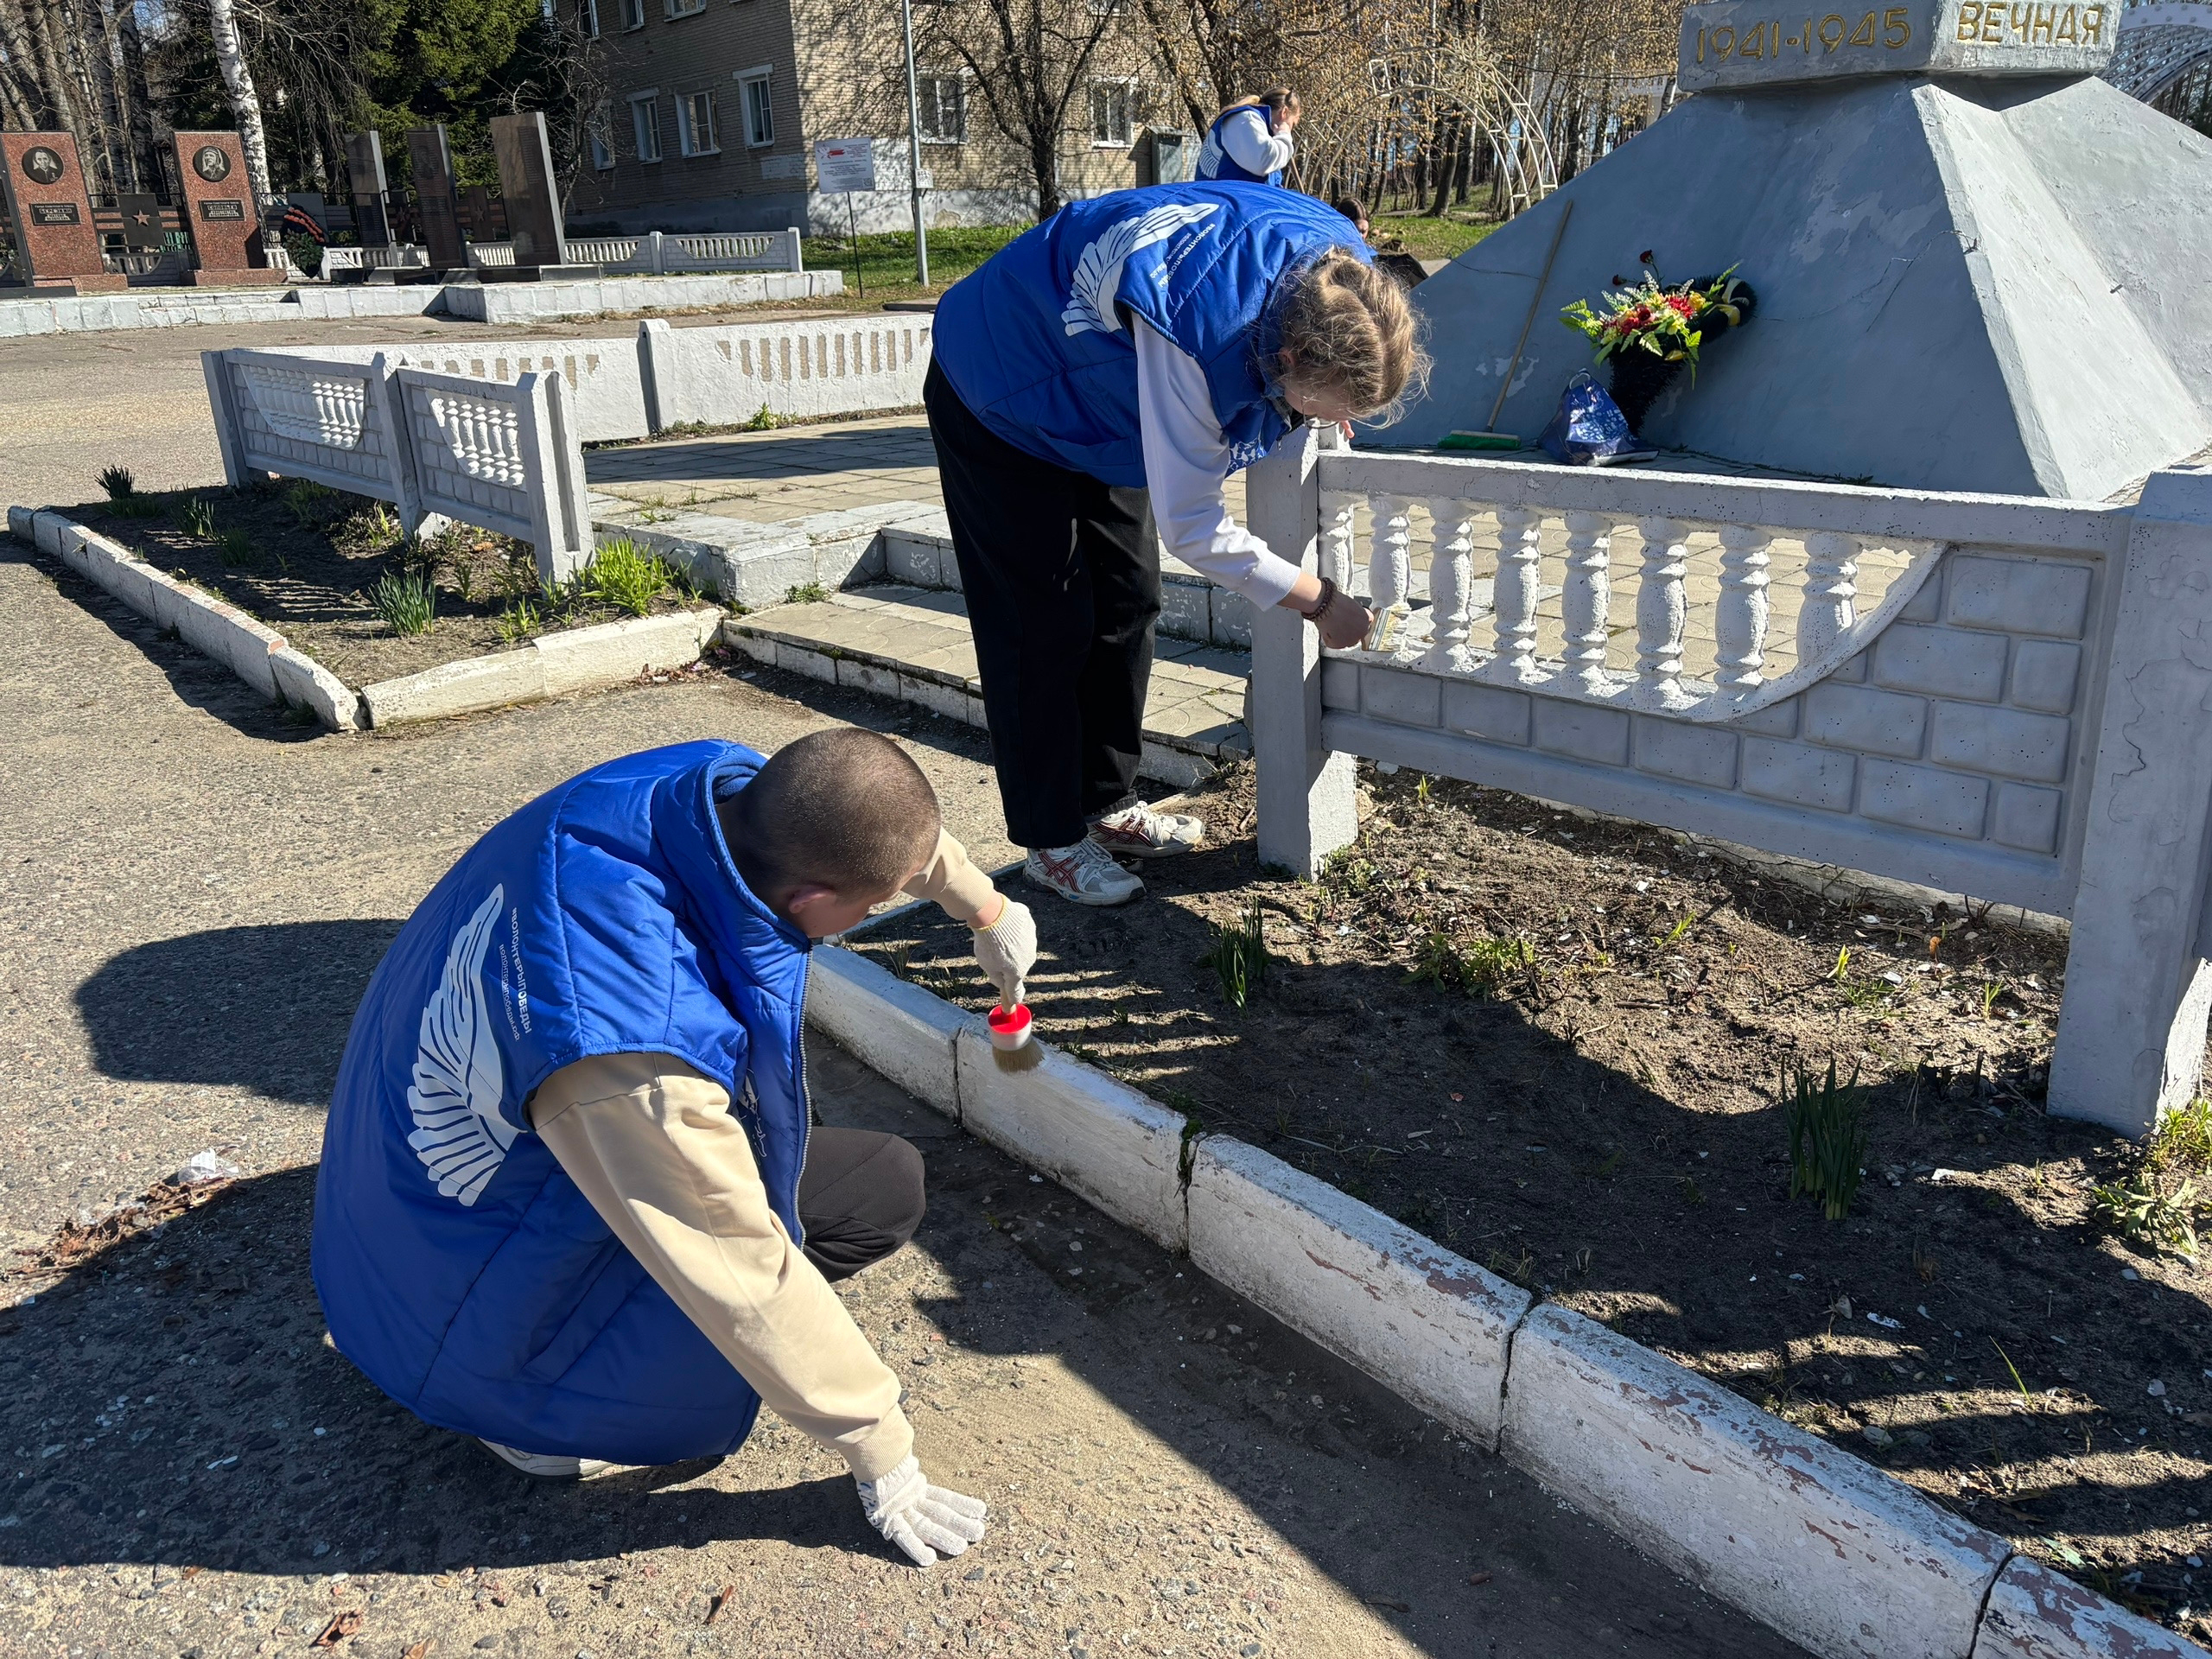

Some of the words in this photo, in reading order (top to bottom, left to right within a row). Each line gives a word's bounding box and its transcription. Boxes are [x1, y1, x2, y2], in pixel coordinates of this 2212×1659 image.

[1696, 8, 1910, 64] 1941-1945
[1957, 2, 2104, 46] ВЕЧНАЯ
[511, 907, 532, 1034] #ВОЛОНТЕРЫПОБЕДЫ
